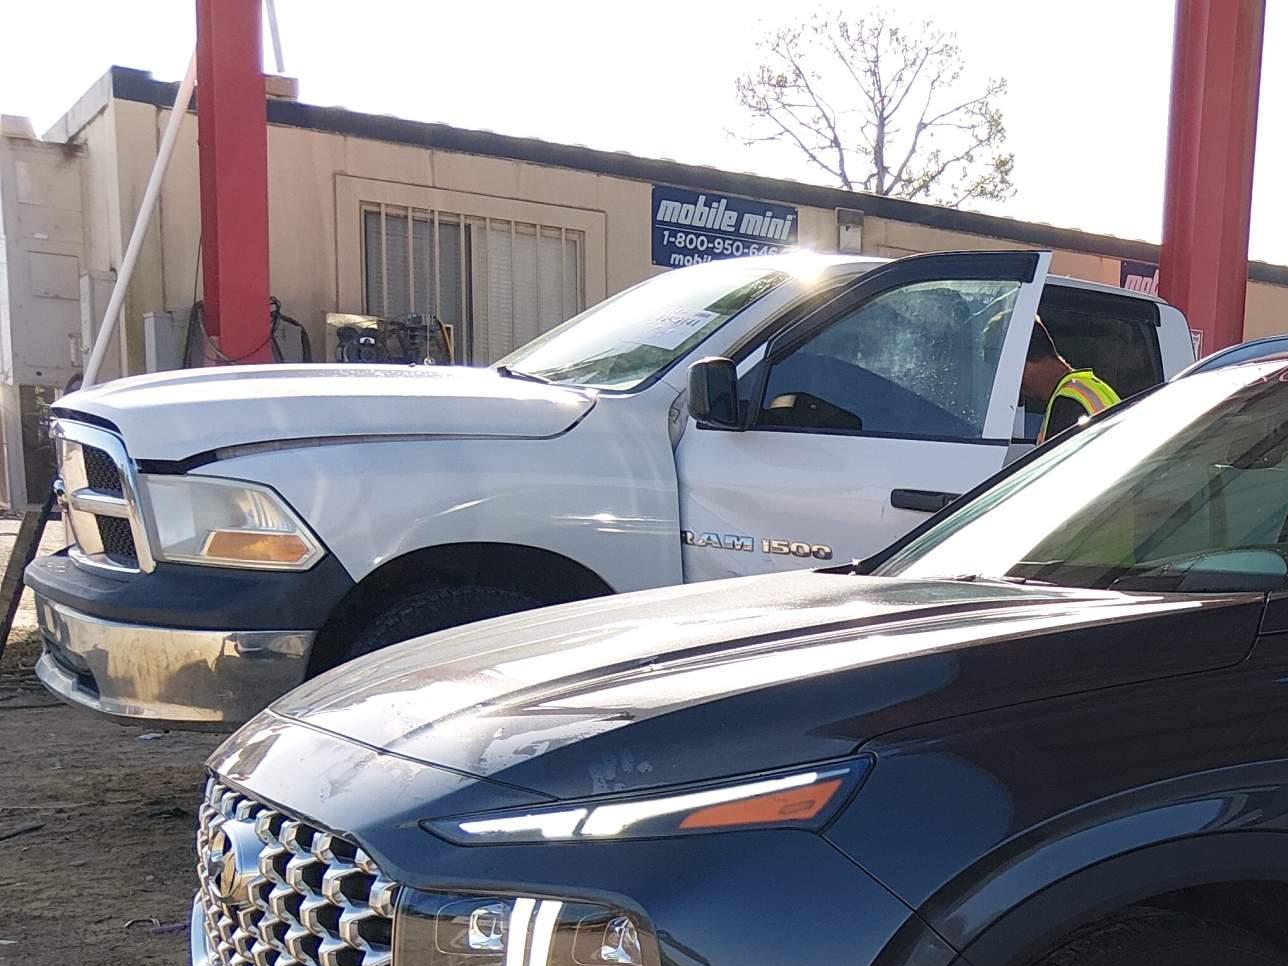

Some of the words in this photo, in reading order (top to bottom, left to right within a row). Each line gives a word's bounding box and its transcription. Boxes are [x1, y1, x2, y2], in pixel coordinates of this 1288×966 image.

[656, 195, 738, 232] mobile
[739, 210, 793, 240] mini
[662, 230, 795, 256] 1-800-950-646
[1124, 268, 1160, 297] mob
[761, 537, 833, 560] 1500
